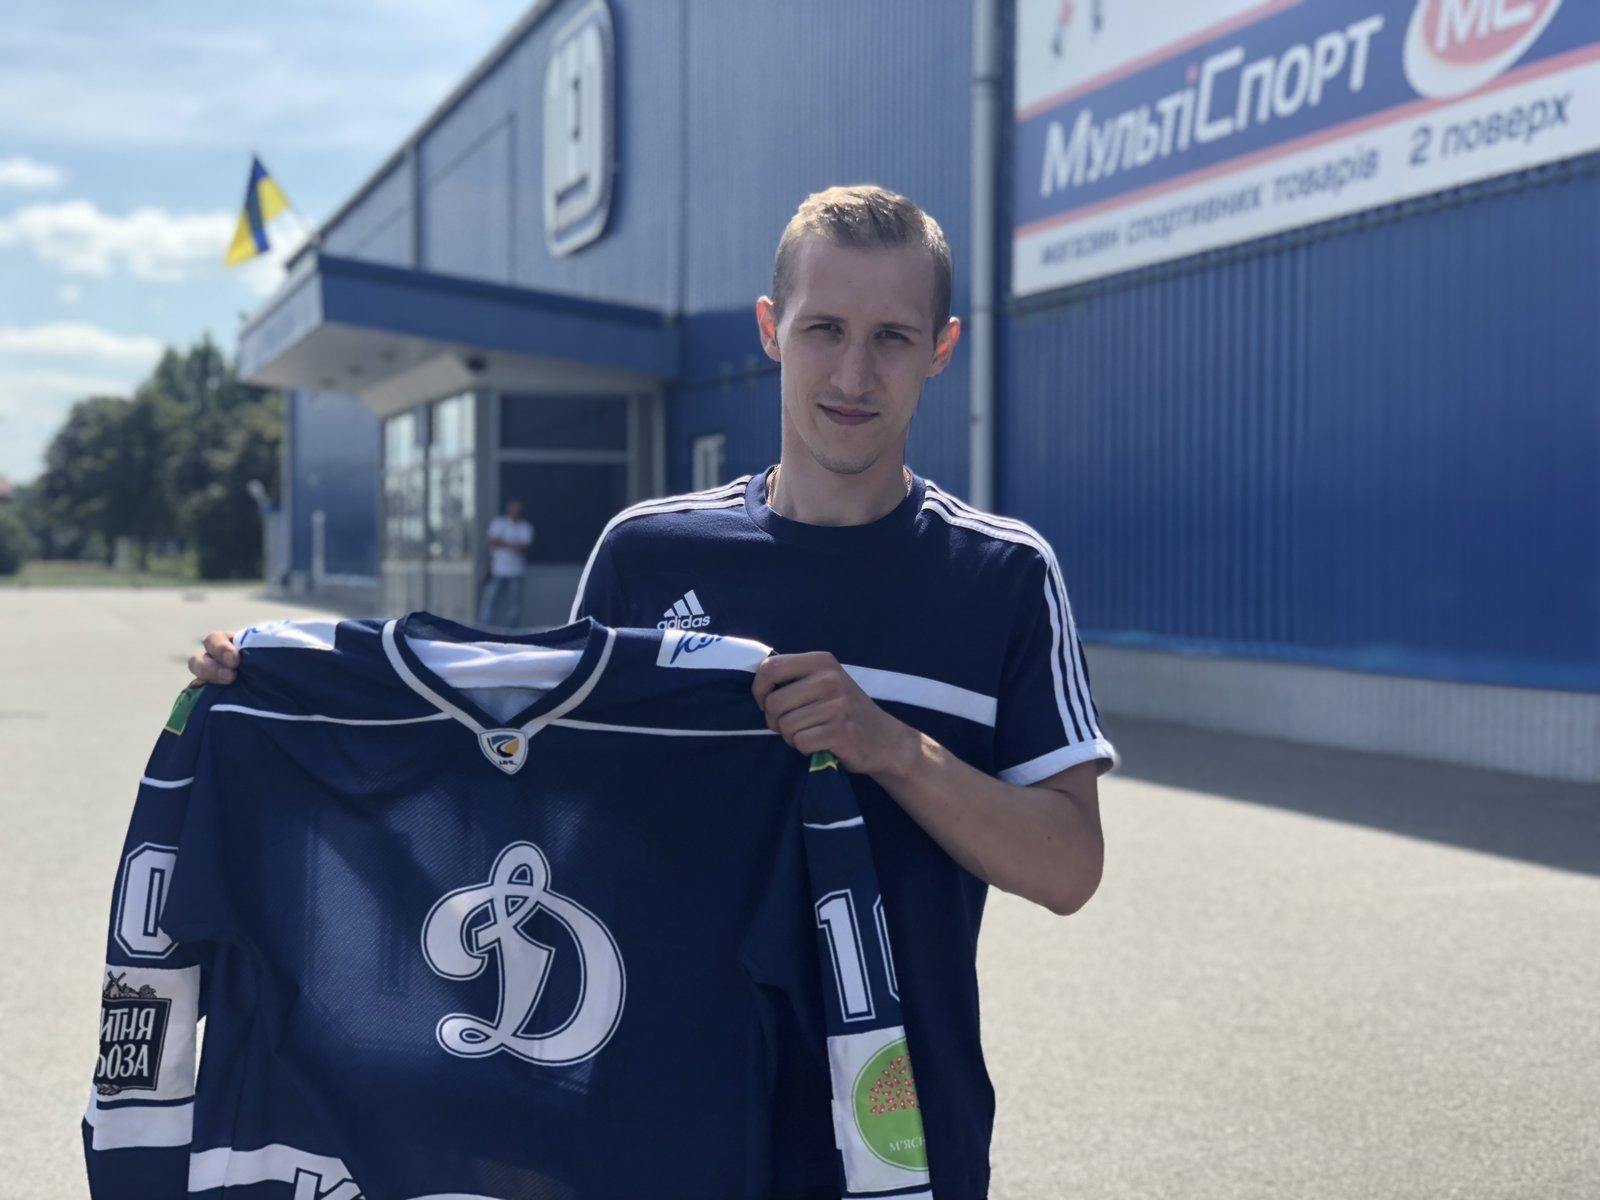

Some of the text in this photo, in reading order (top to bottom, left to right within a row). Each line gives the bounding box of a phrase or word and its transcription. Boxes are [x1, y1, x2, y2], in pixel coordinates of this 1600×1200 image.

[1408, 123, 1433, 166] 2
[1439, 91, 1573, 158] поверх
[656, 614, 711, 631] adidas
